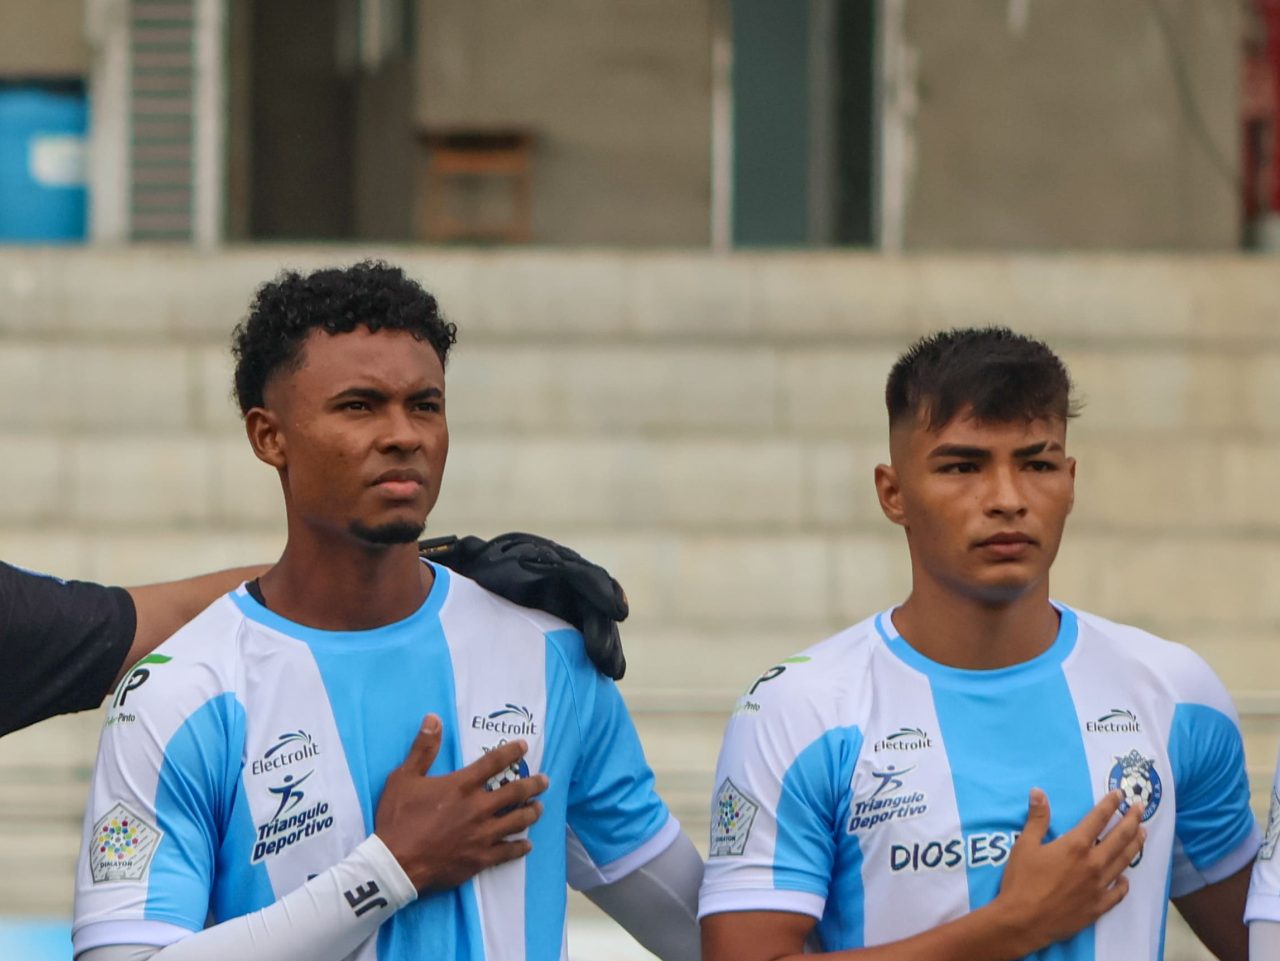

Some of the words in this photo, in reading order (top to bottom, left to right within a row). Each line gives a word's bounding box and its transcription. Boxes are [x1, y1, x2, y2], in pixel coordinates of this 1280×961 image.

[117, 712, 136, 723] Pinto
[471, 715, 537, 735] Electrolit
[1086, 721, 1141, 732] Electrolit
[873, 738, 933, 752] Electrolit
[252, 742, 320, 775] Electrolit
[855, 792, 925, 816] Triangulo
[258, 801, 329, 841] Triangulo
[849, 804, 927, 832] Deportivo
[252, 815, 334, 862] Deportivo
[890, 839, 963, 872] DIOS
[970, 835, 1009, 865] ES
